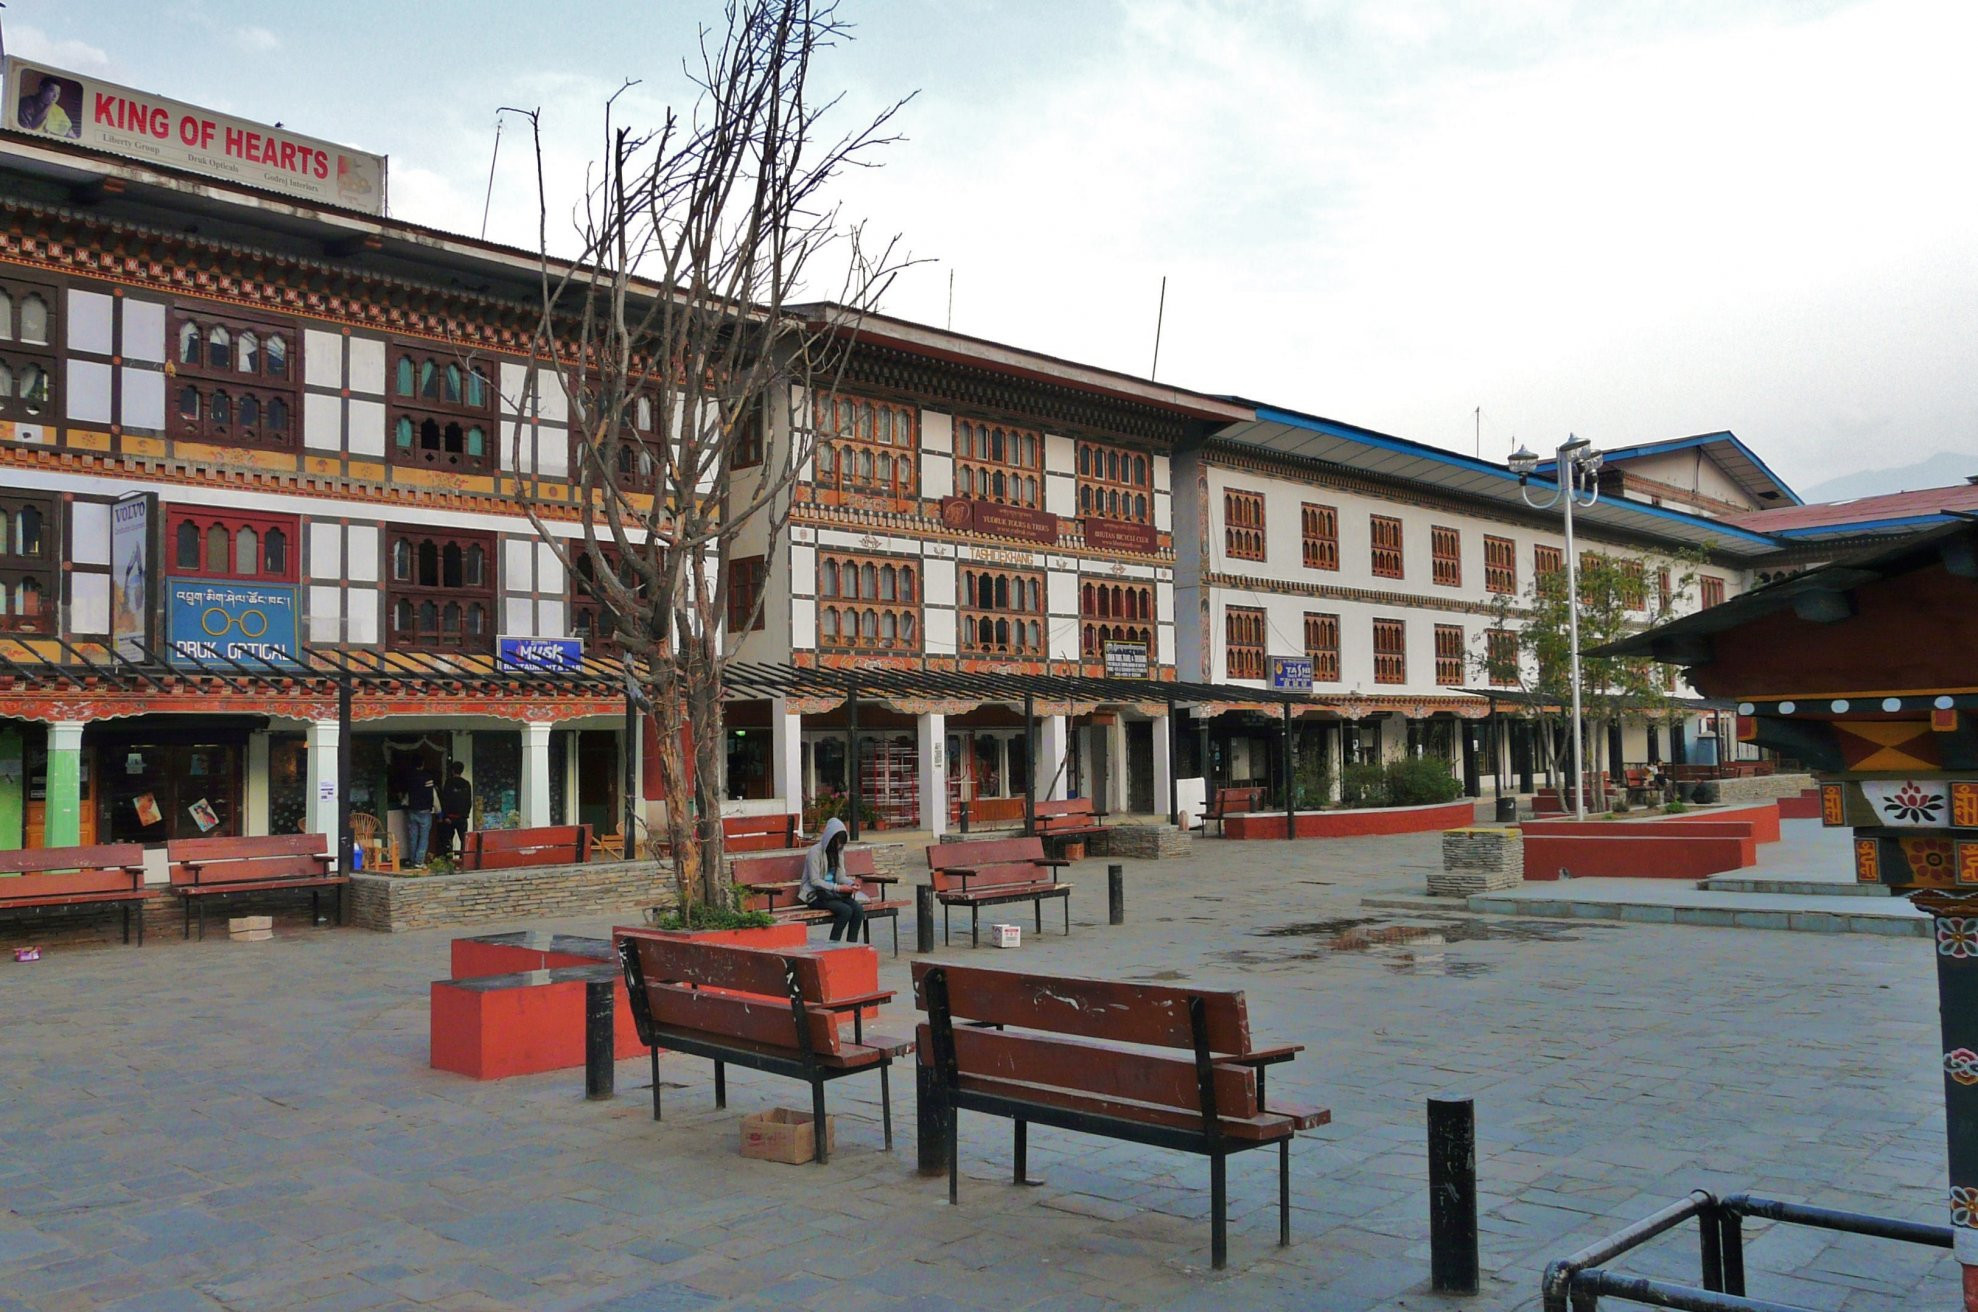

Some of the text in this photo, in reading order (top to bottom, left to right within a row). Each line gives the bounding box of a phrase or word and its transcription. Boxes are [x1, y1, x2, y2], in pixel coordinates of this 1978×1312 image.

[94, 92, 328, 180] KING OF HEARTS
[134, 140, 160, 154] Group
[115, 501, 145, 523] VOLVO
[176, 640, 291, 661] DRUK OPTICAL
